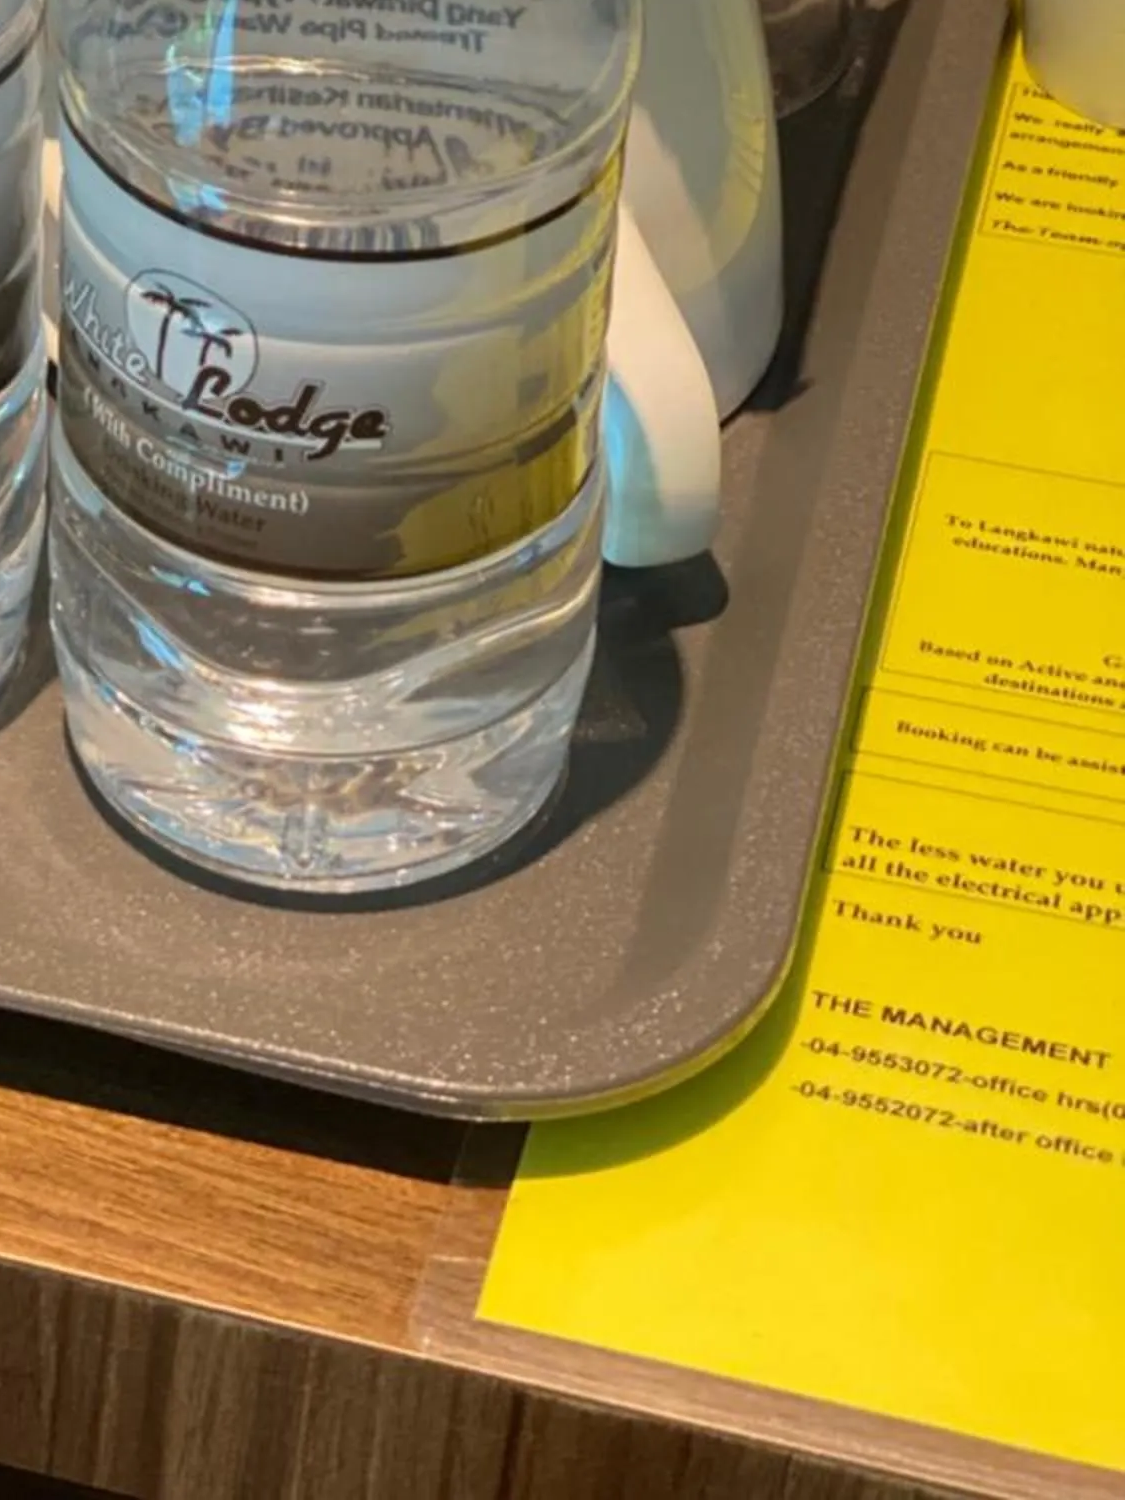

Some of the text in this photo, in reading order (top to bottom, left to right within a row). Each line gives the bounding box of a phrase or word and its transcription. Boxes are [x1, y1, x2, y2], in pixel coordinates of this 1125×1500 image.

[182, 364, 388, 460] Lodge
[136, 438, 310, 514] Compliment)
[979, 520, 1079, 549] Langkawi
[1075, 555, 1125, 579] Man
[919, 639, 981, 663] Based
[1017, 659, 1088, 682] Active
[896, 719, 987, 752] Booking
[992, 741, 1030, 757] can
[850, 825, 903, 851] The
[909, 836, 961, 862] less
[970, 852, 1048, 880] water
[1053, 868, 1105, 890] you
[842, 853, 878, 873] all
[885, 861, 930, 884] the
[936, 873, 1062, 910] electrical
[833, 899, 984, 945] Thank you
[811, 988, 1112, 1070] THE MANAGEMENT
[1035, 1134, 1114, 1164] office
